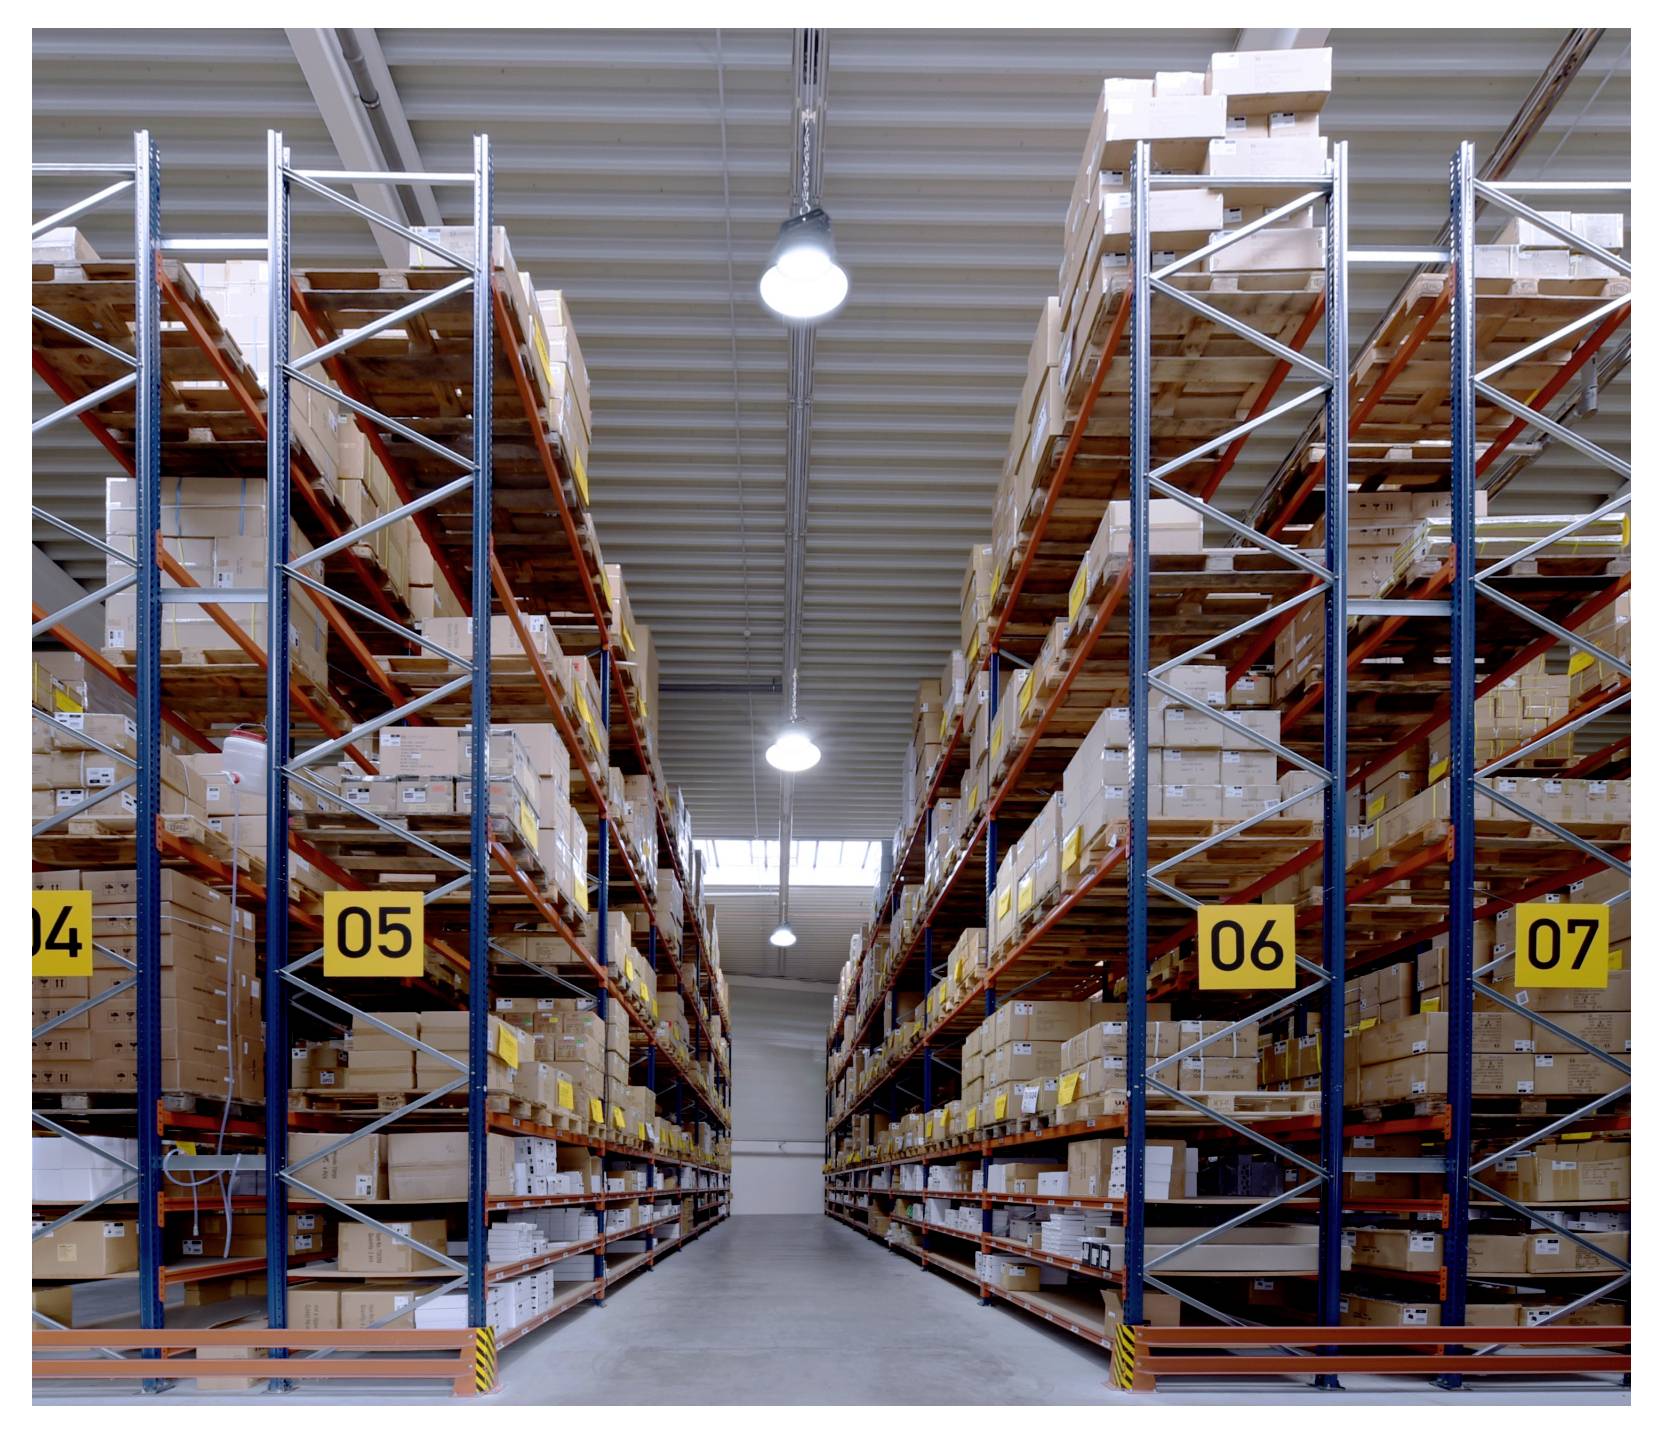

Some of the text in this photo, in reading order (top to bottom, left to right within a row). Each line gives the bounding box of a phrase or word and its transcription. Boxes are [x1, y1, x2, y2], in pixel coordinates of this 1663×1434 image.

[337, 906, 412, 959] 05
[1210, 919, 1284, 972] 06
[1528, 918, 1600, 970] 07
